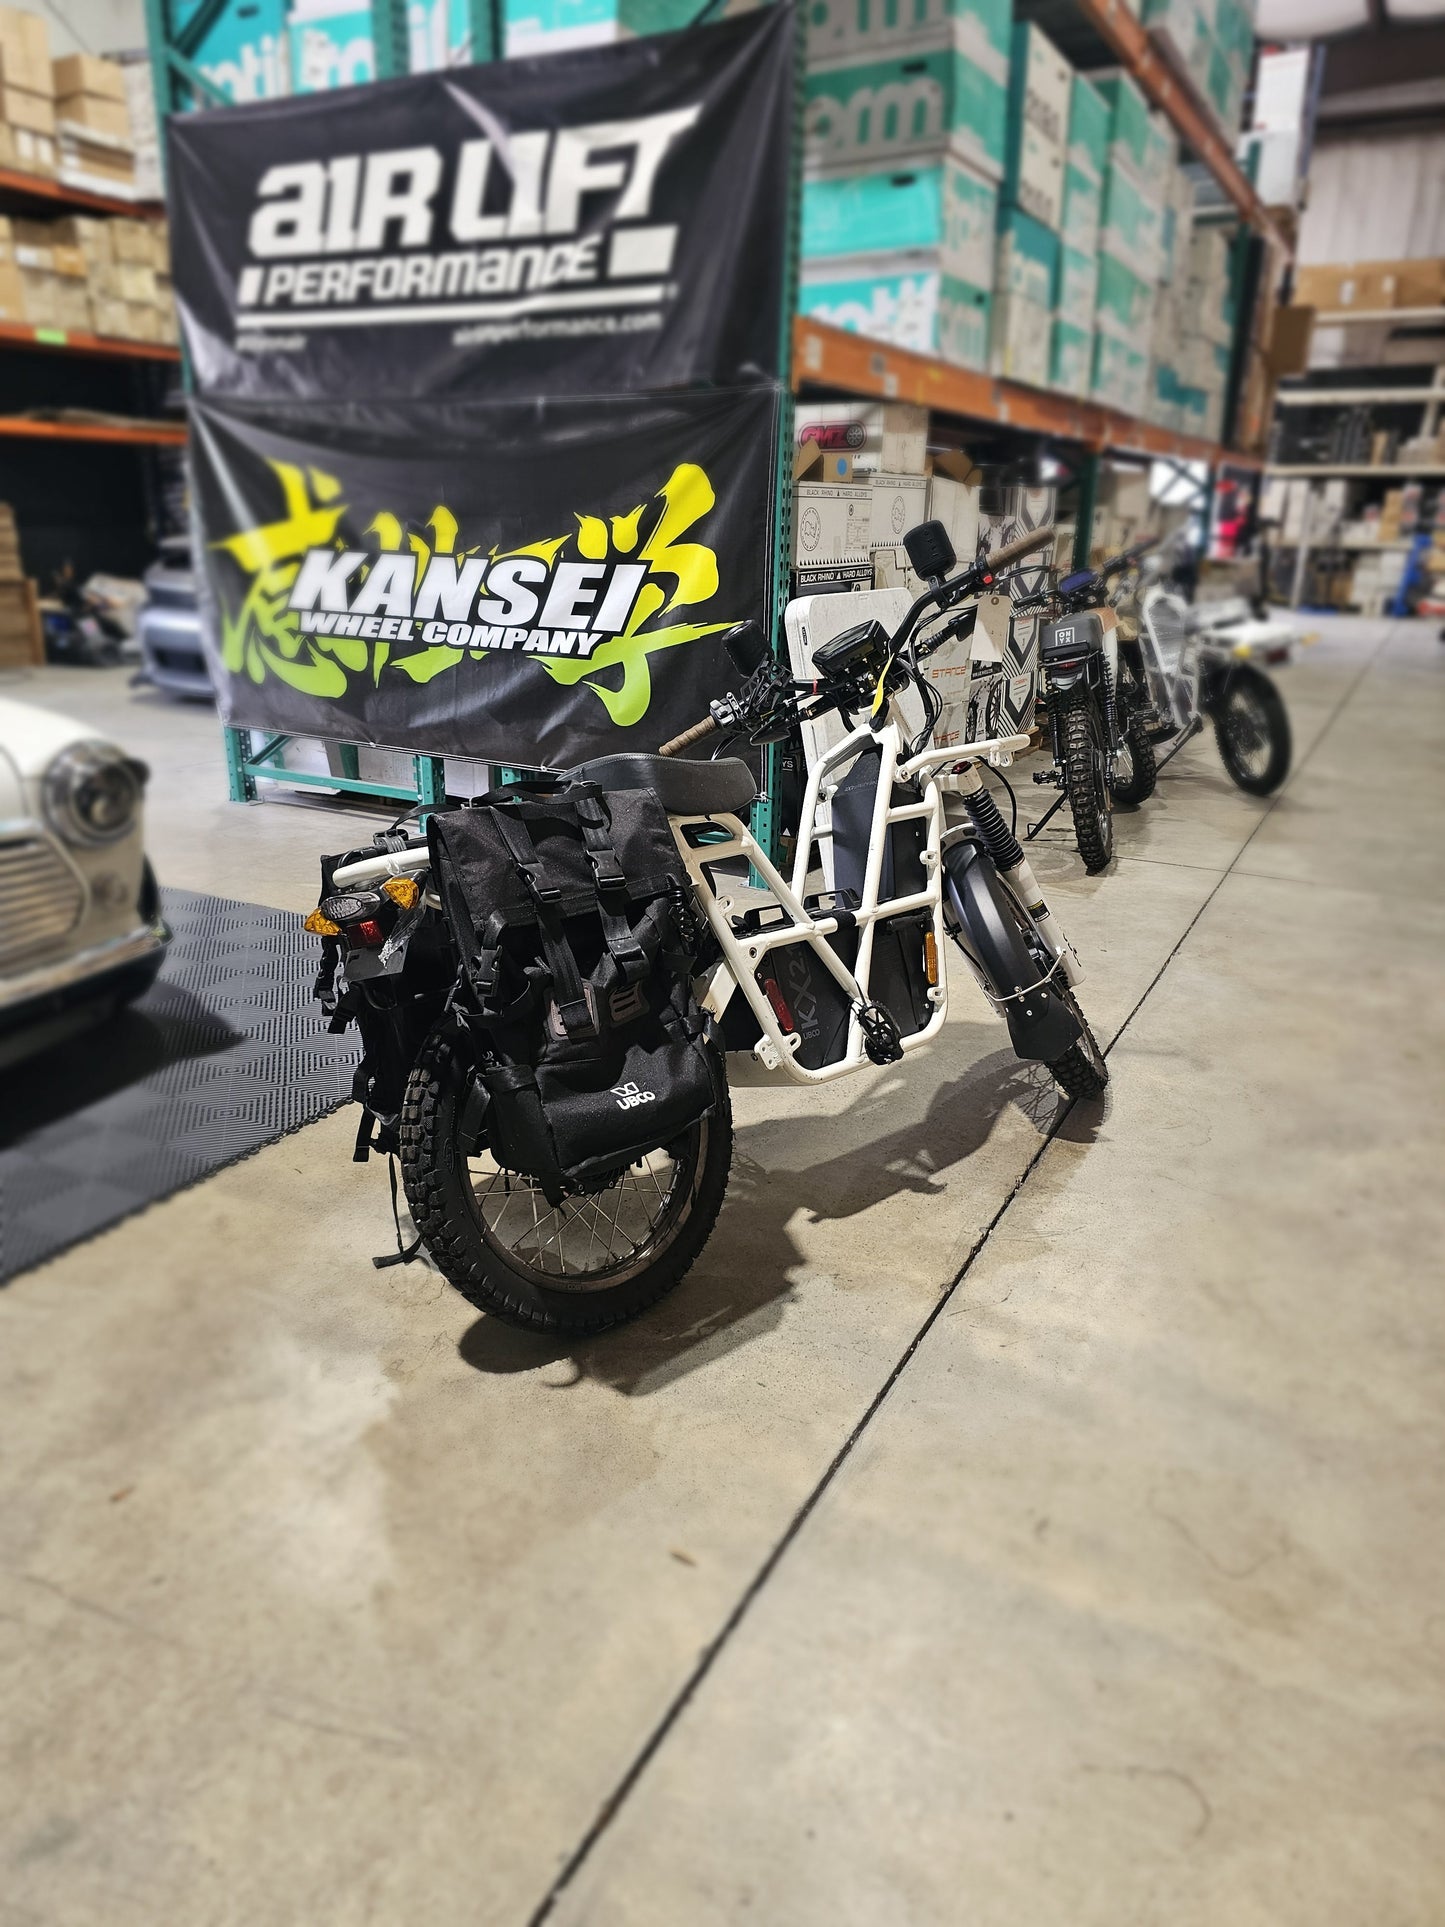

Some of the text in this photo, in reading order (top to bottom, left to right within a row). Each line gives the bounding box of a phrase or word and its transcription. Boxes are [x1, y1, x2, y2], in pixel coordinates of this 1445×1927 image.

[450, 104, 703, 241] LIFT
[288, 549, 648, 633] KANSEI
[800, 568, 873, 583] BLACK RHINO HARD ALLOYS
[299, 611, 603, 656] WHEEL COMPANY
[802, 1028, 821, 1041] UBCO
[616, 1091, 656, 1110] UBCO
